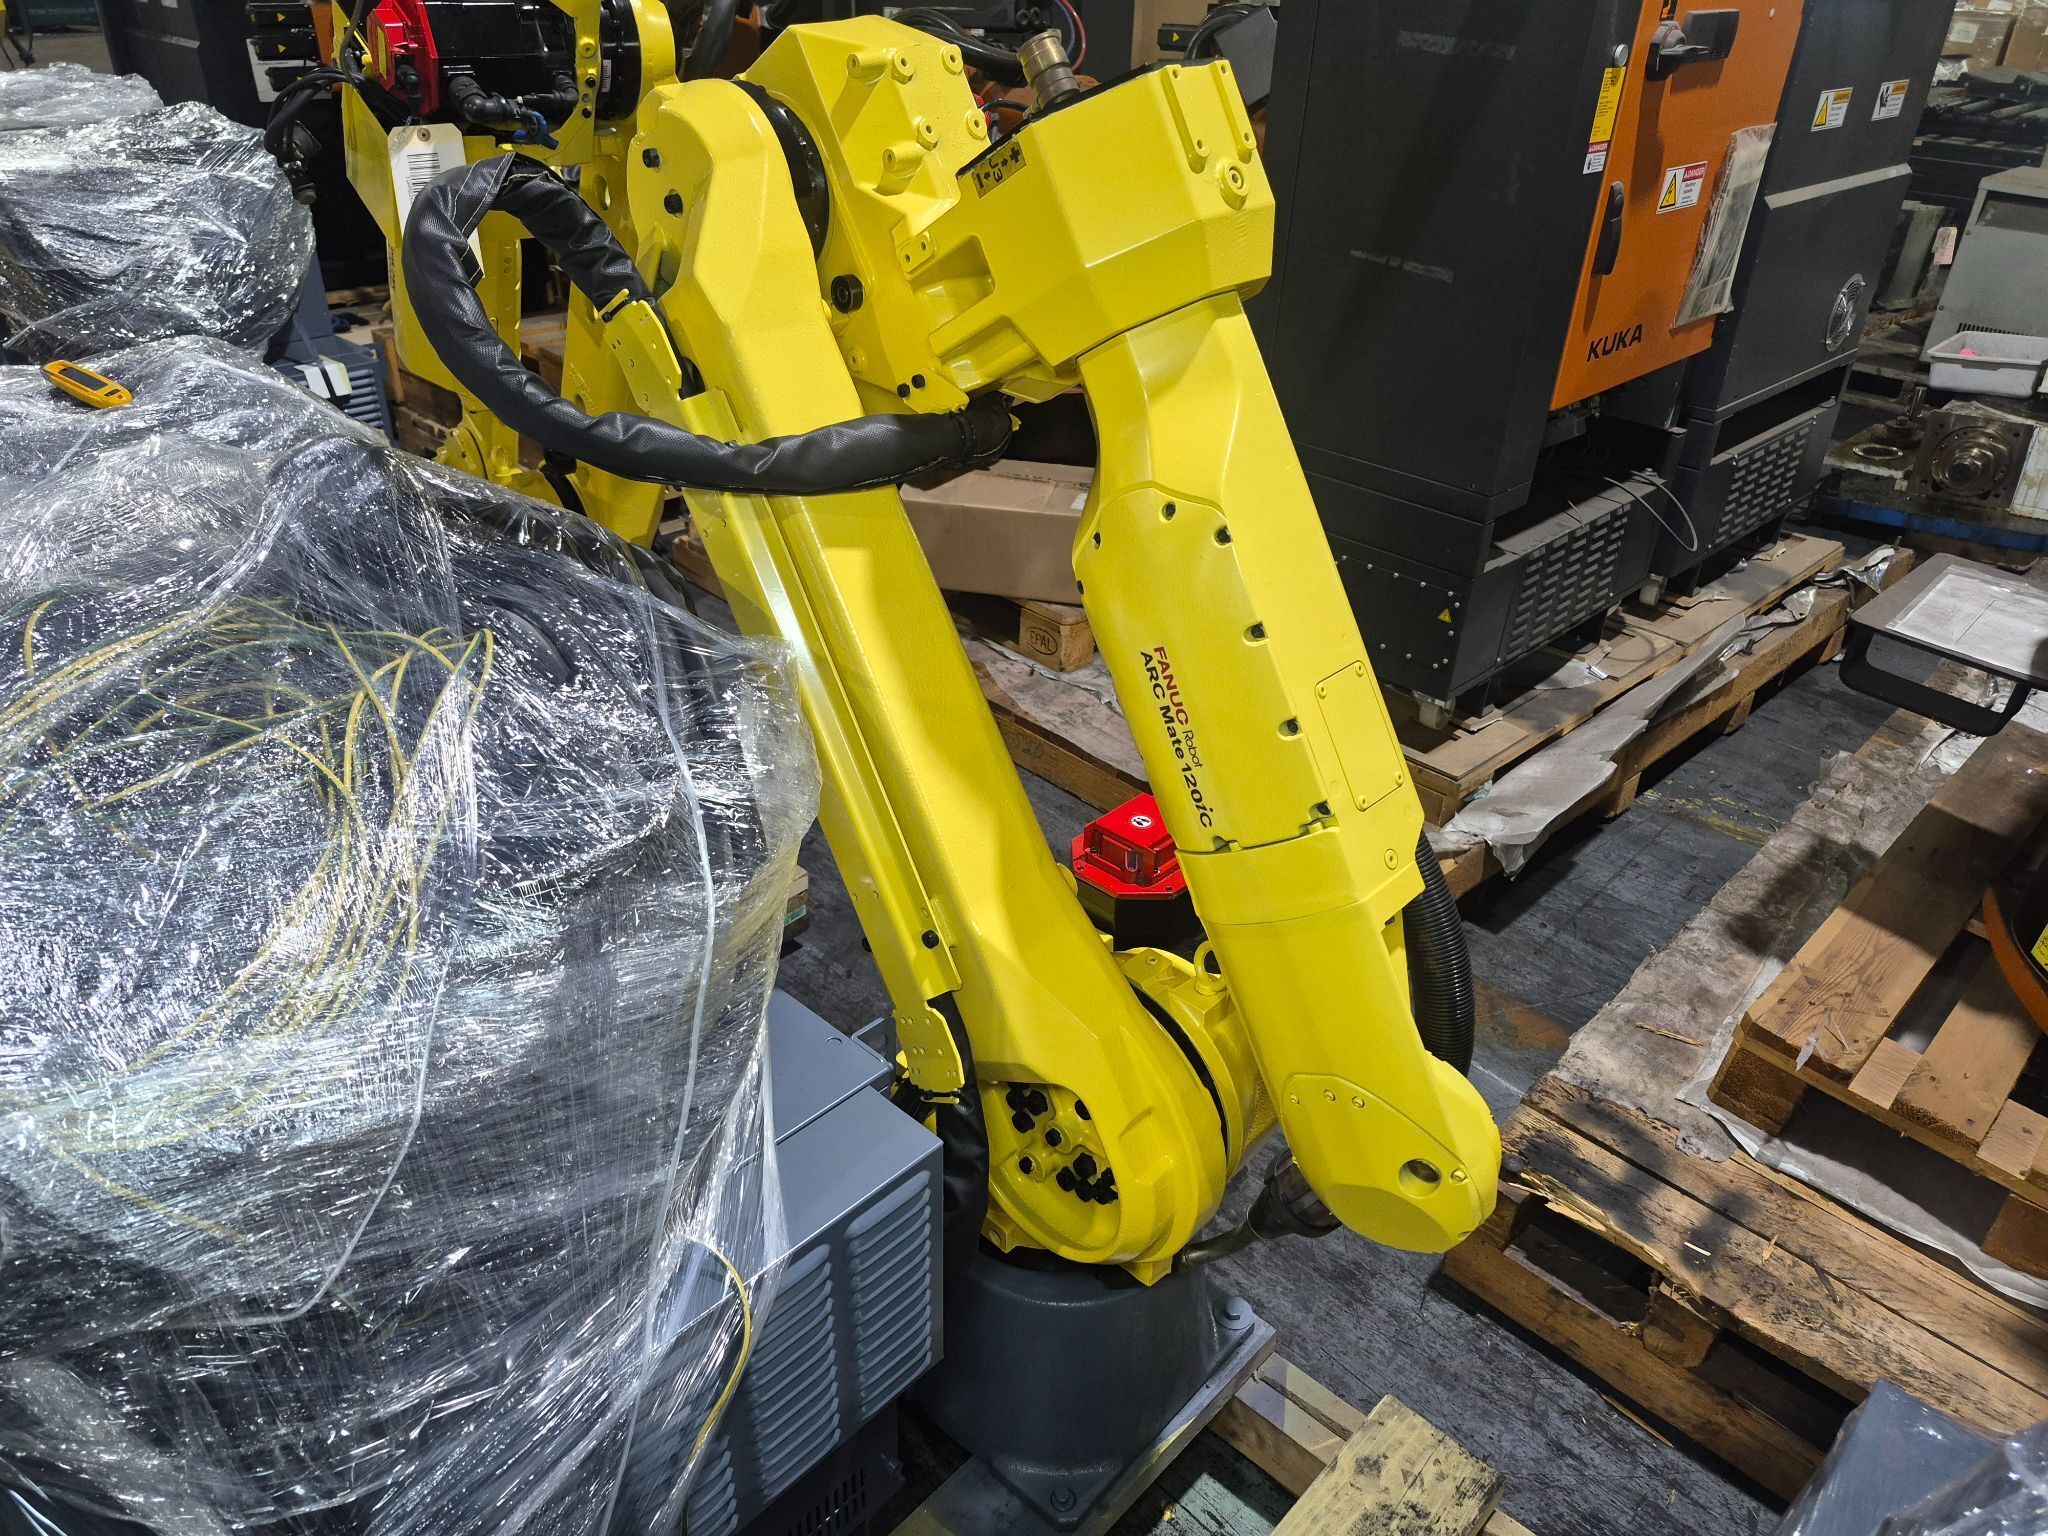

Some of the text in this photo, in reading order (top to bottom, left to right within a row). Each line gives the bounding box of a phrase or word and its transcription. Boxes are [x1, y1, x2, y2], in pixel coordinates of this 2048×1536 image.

[1586, 323, 1643, 363] KUKA
[1030, 630, 1053, 652] EPAL
[1140, 651, 1214, 829] ARC Mate 120iC
[1153, 646, 1204, 768] FANUC Robot
